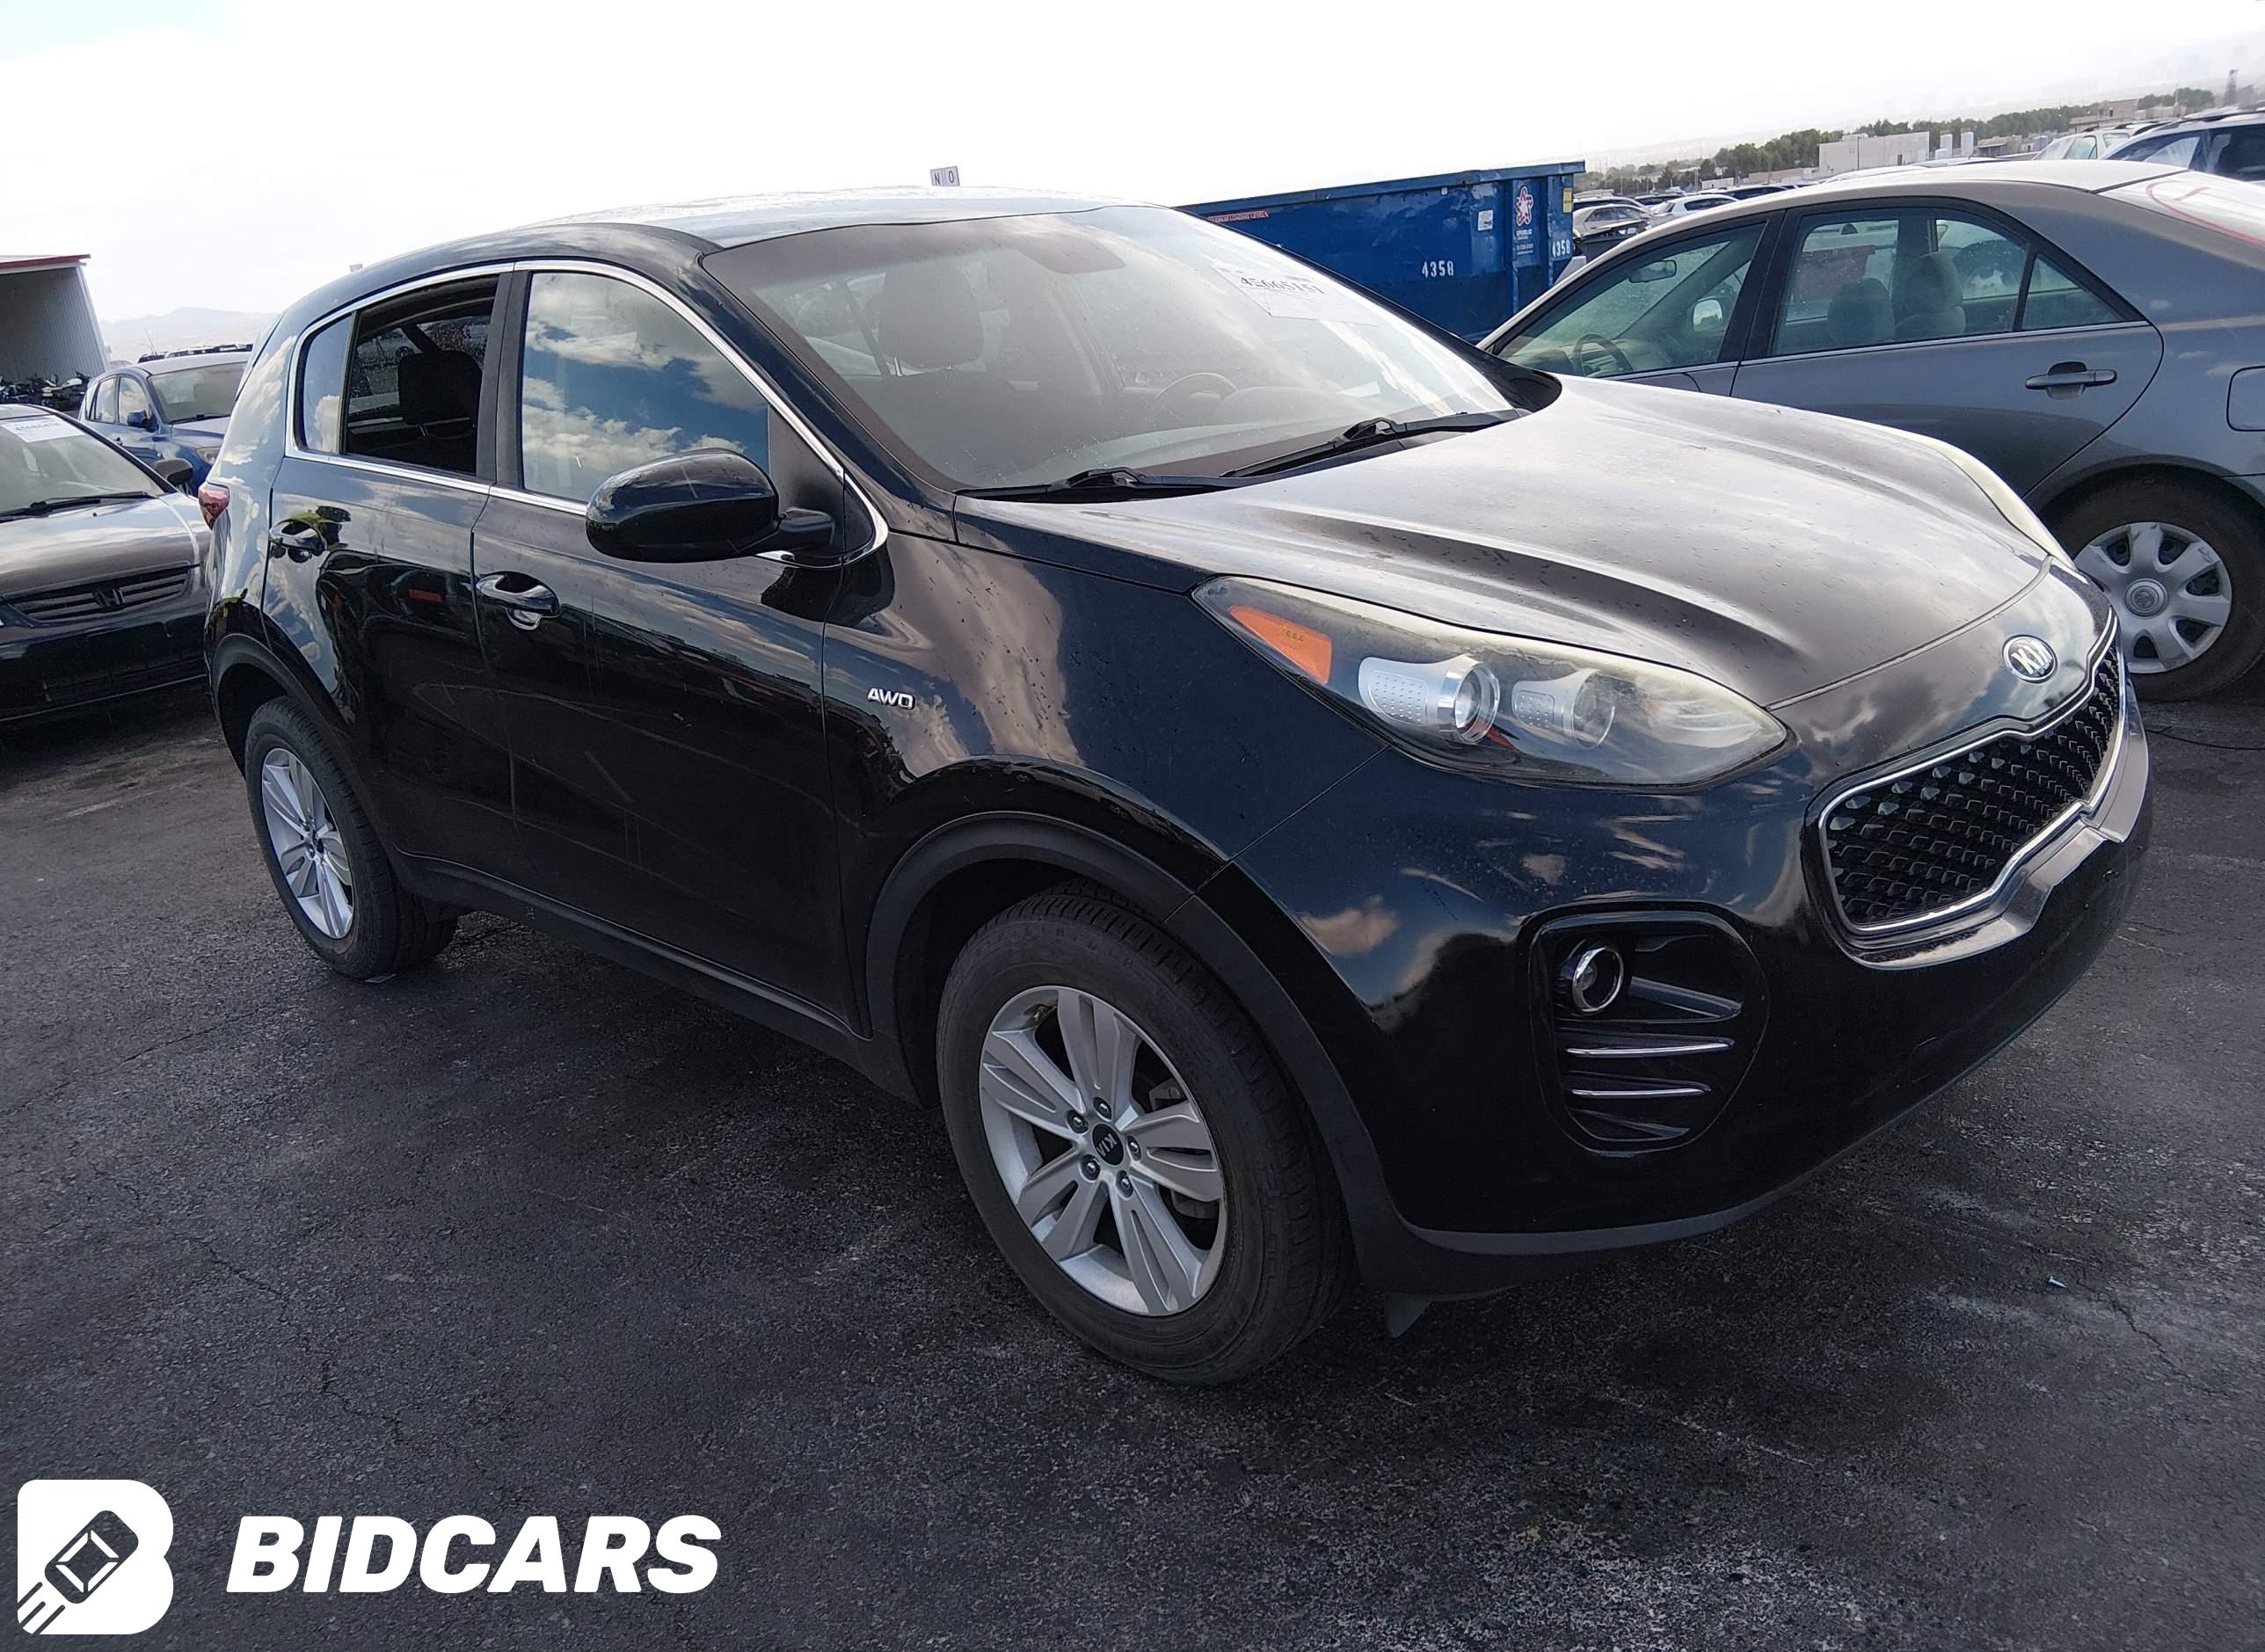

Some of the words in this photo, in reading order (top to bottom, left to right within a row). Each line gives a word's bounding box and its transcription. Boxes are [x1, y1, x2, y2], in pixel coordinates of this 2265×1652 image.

[1422, 259, 1454, 278] 4358
[867, 688, 914, 710] AWD
[1096, 1132, 1118, 1157] KIA
